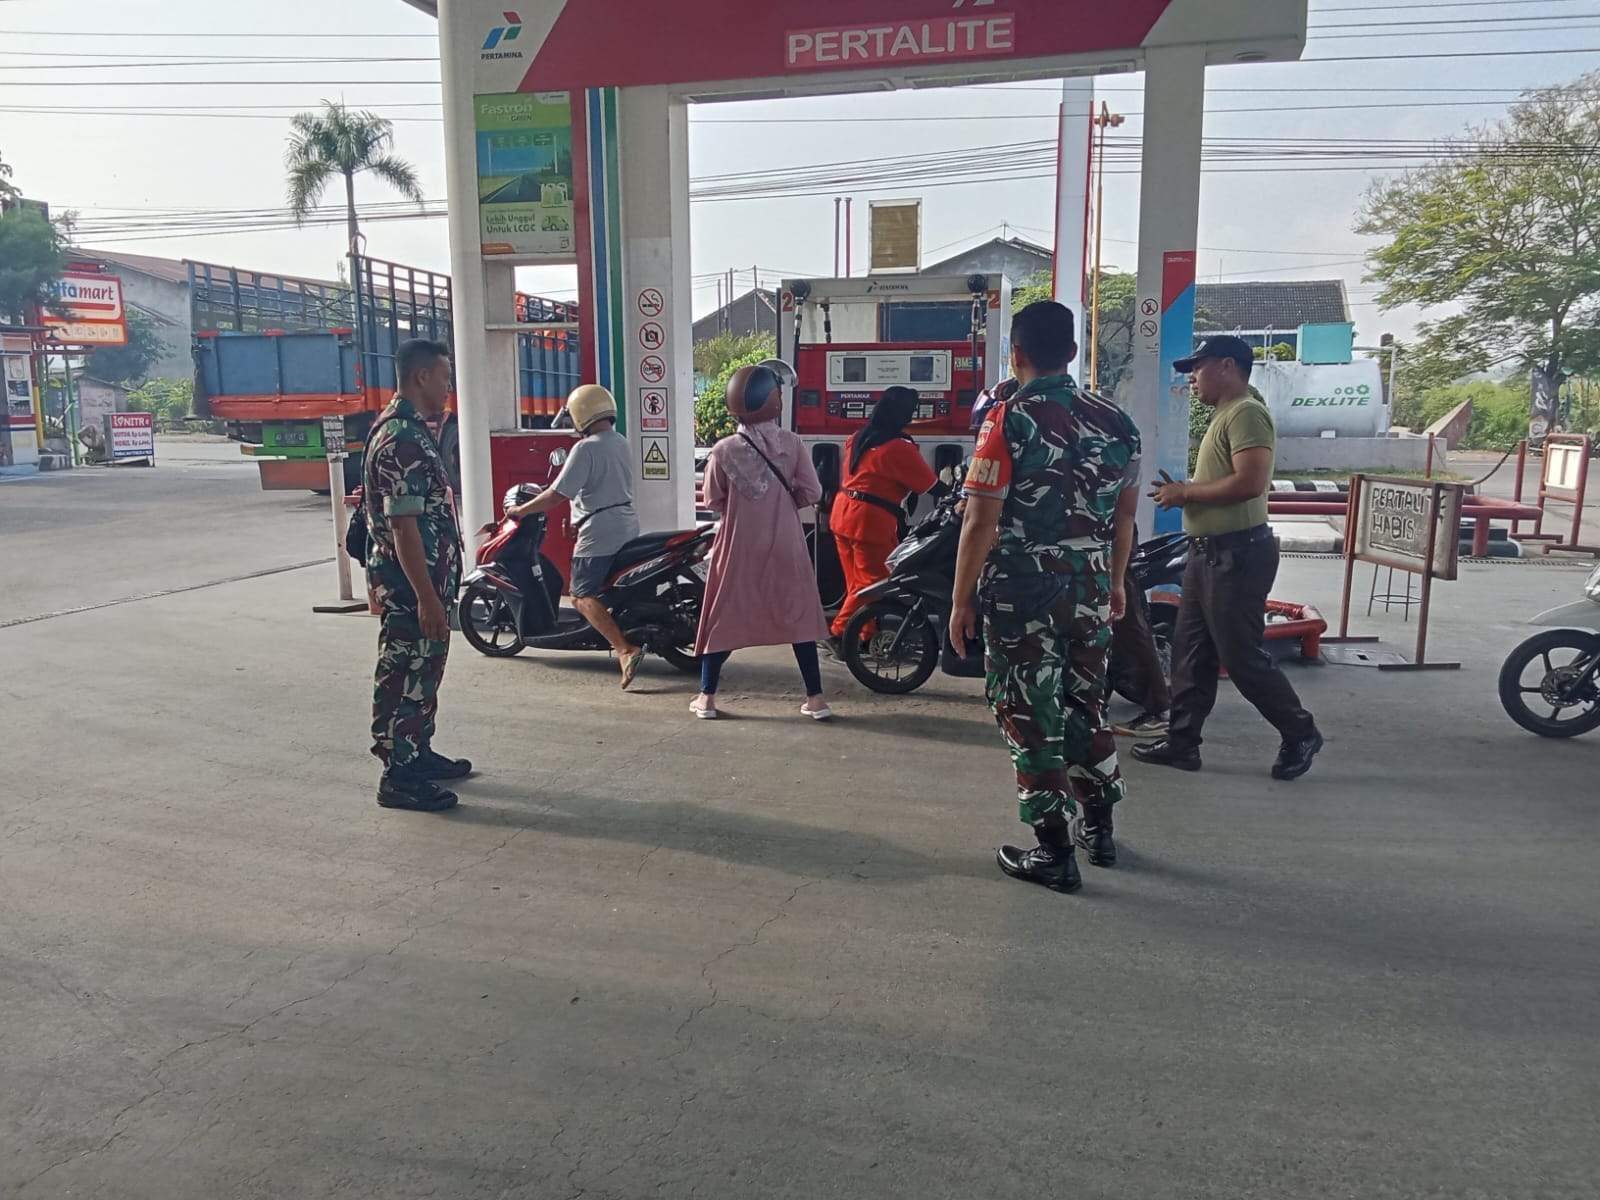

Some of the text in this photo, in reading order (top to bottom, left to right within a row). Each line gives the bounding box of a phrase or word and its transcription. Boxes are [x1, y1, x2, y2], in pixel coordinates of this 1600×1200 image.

[788, 17, 1012, 64] PERTALITE
[480, 51, 523, 60] PERTAMINA
[782, 292, 793, 312] 2
[988, 290, 999, 309] 2
[1291, 397, 1370, 407] DEXLITE
[1373, 513, 1414, 539] HABIS
